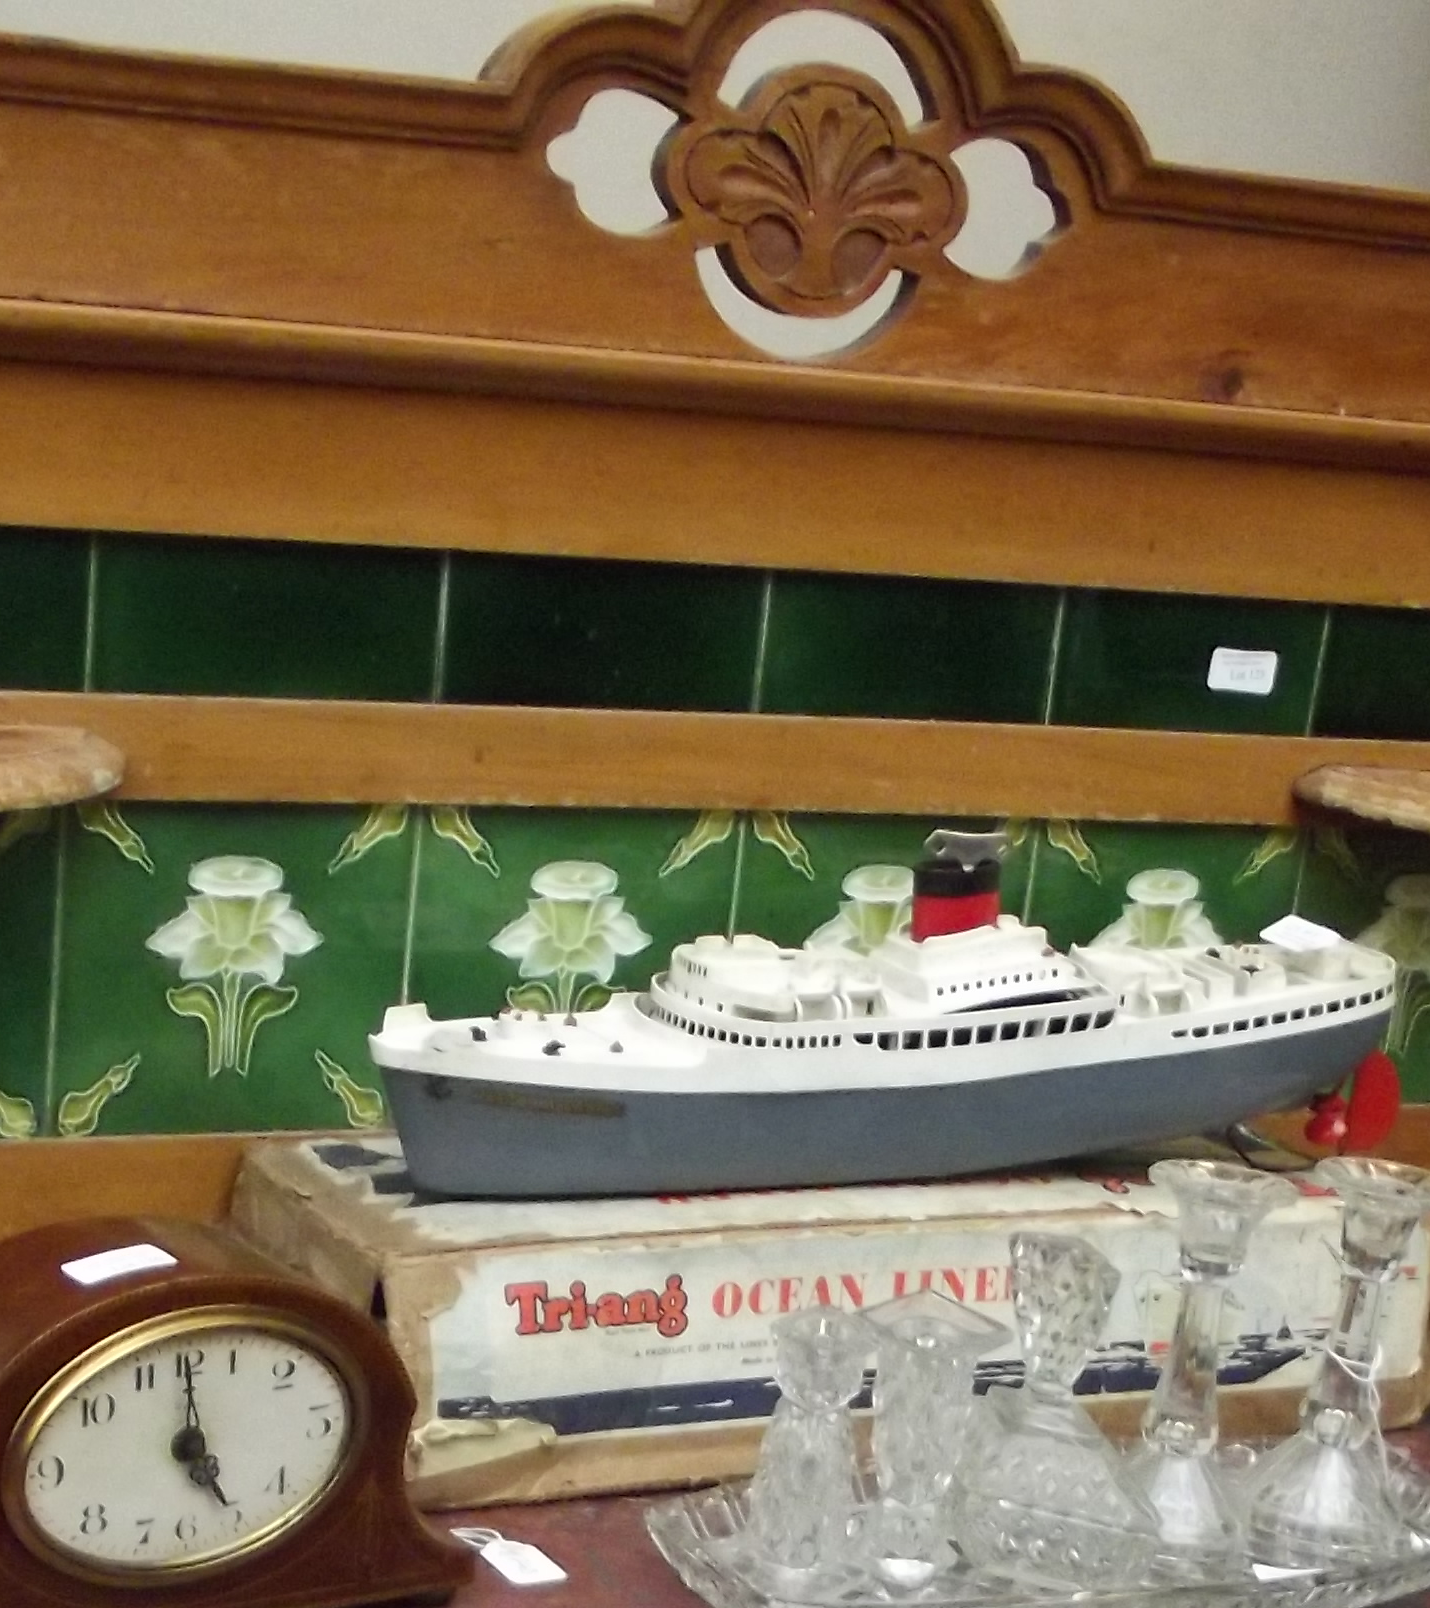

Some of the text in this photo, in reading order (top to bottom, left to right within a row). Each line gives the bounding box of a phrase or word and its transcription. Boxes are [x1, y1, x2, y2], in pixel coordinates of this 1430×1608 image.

[504, 1273, 688, 1338] Tri-ang
[711, 1272, 868, 1319] OCEAN
[135, 1362, 154, 1392] 11
[229, 1348, 237, 1376] 1
[272, 1359, 296, 1390] 2
[82, 1392, 116, 1428] 10
[307, 1403, 332, 1440] 3
[37, 1455, 64, 1491] 9
[264, 1465, 299, 1496] 4
[79, 1503, 108, 1535] 8
[135, 1517, 155, 1545] 7
[175, 1514, 197, 1541] 6
